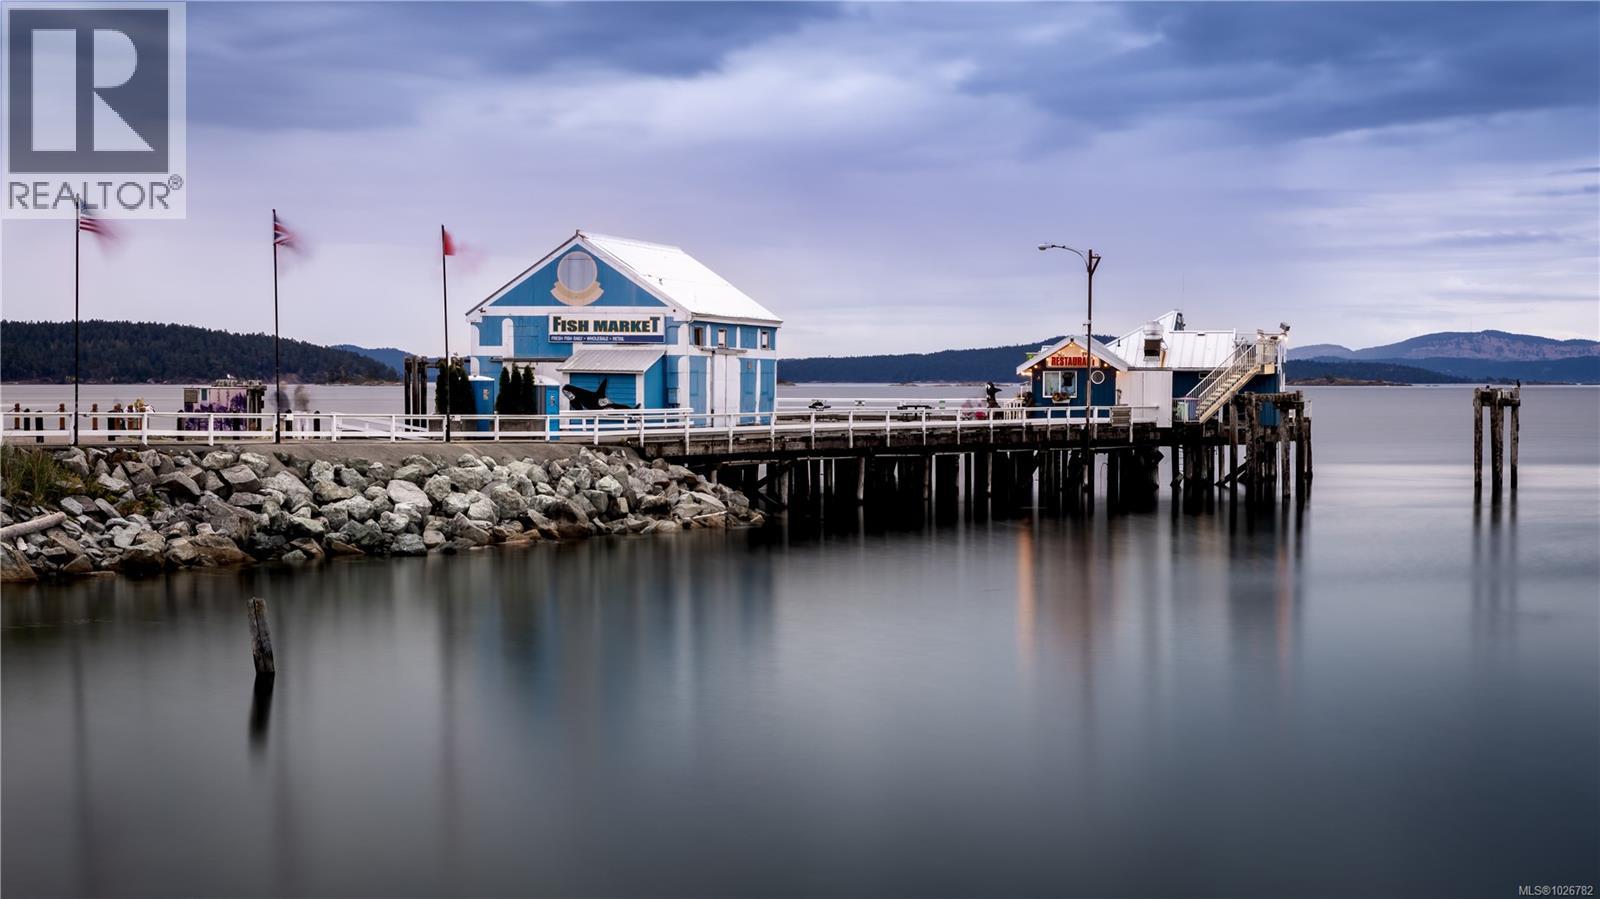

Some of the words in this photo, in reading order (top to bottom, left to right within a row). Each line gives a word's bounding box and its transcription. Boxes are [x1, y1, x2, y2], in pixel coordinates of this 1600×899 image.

[553, 316, 589, 332] FISH
[593, 316, 660, 332] MARKET
[1051, 356, 1095, 366] RESTAURAT
